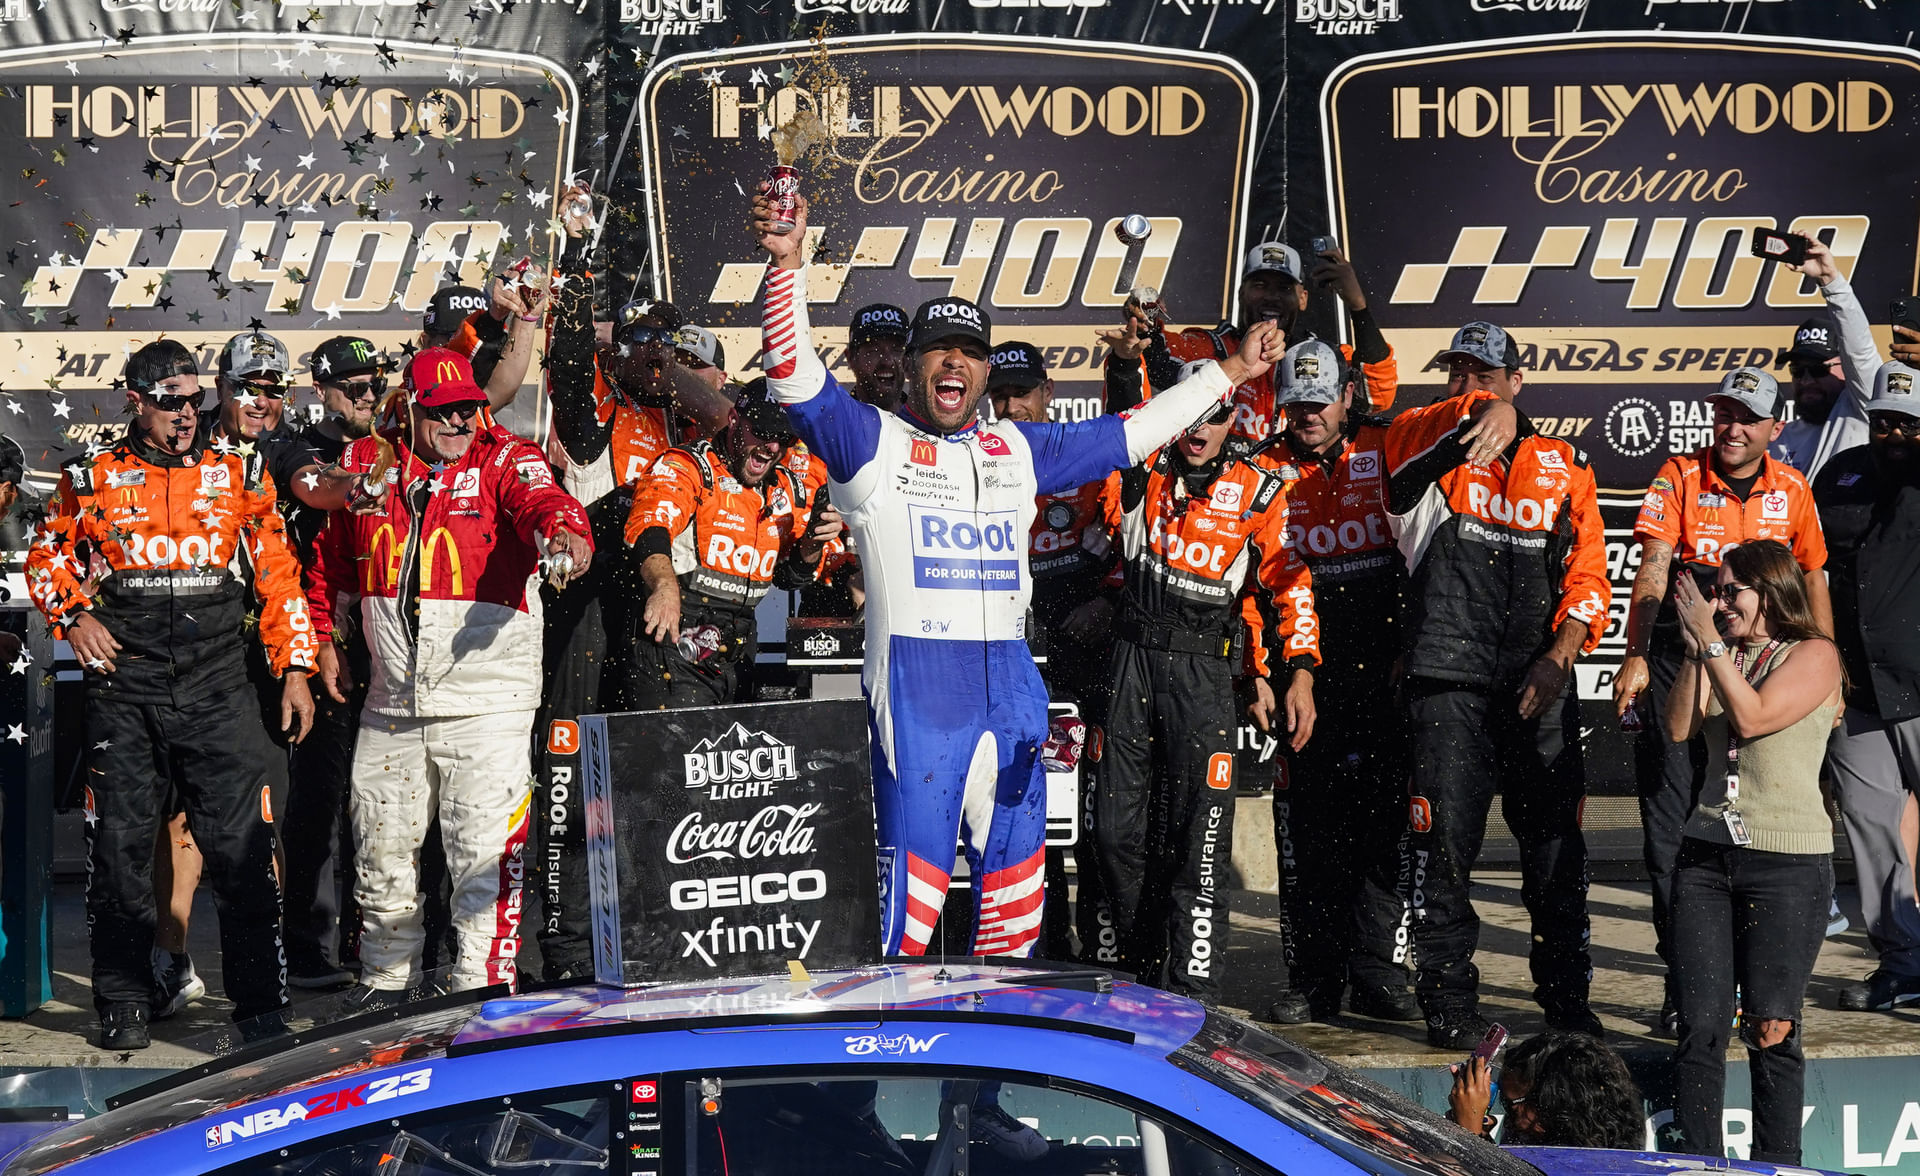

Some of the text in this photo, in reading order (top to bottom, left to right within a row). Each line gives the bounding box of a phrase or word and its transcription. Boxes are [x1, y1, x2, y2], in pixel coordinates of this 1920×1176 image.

[639, 20, 700, 35] LIGHT
[1315, 20, 1376, 35] LIGHT
[25, 84, 525, 141] HOLLYWOOD
[711, 85, 1206, 138] HOLLYWOOD
[1393, 81, 1894, 138] HOLLYWOOD
[148, 118, 390, 207] Casino
[833, 119, 1064, 204] Casino
[1512, 118, 1748, 203] Casino
[909, 217, 1183, 308] 400
[1591, 215, 1870, 309] 400
[928, 303, 981, 325] Root
[948, 317, 983, 332] Insurance
[56, 353, 111, 377] AT
[1517, 338, 1650, 373] ANSAS
[1652, 347, 1792, 372] SPEED
[1557, 418, 1593, 437] BY
[912, 480, 960, 491] DOORDASH
[916, 468, 949, 481] leidos
[1468, 482, 1557, 530] Root
[119, 532, 223, 566] Root
[921, 515, 1015, 552] Root
[1288, 513, 1386, 555] Root
[706, 534, 778, 578] Roo
[925, 568, 1017, 580] FOR OUR VETERANS
[1032, 553, 1080, 571] DRIVERS
[123, 575, 224, 588] FOR GOOD DRIVERS
[696, 574, 721, 589] FOR
[1177, 578, 1227, 597] DRIVERS
[1288, 586, 1316, 651] Root
[804, 640, 840, 652] BUSCH
[684, 745, 797, 788] BUSCH
[550, 766, 572, 836] Root
[709, 781, 774, 800] LIGHT
[590, 728, 610, 917] CUP SERIES
[666, 803, 822, 864] Coca-Cola
[670, 869, 827, 910] GEICO
[1188, 805, 1222, 978] Root Insurance
[681, 914, 822, 967] xfinity
